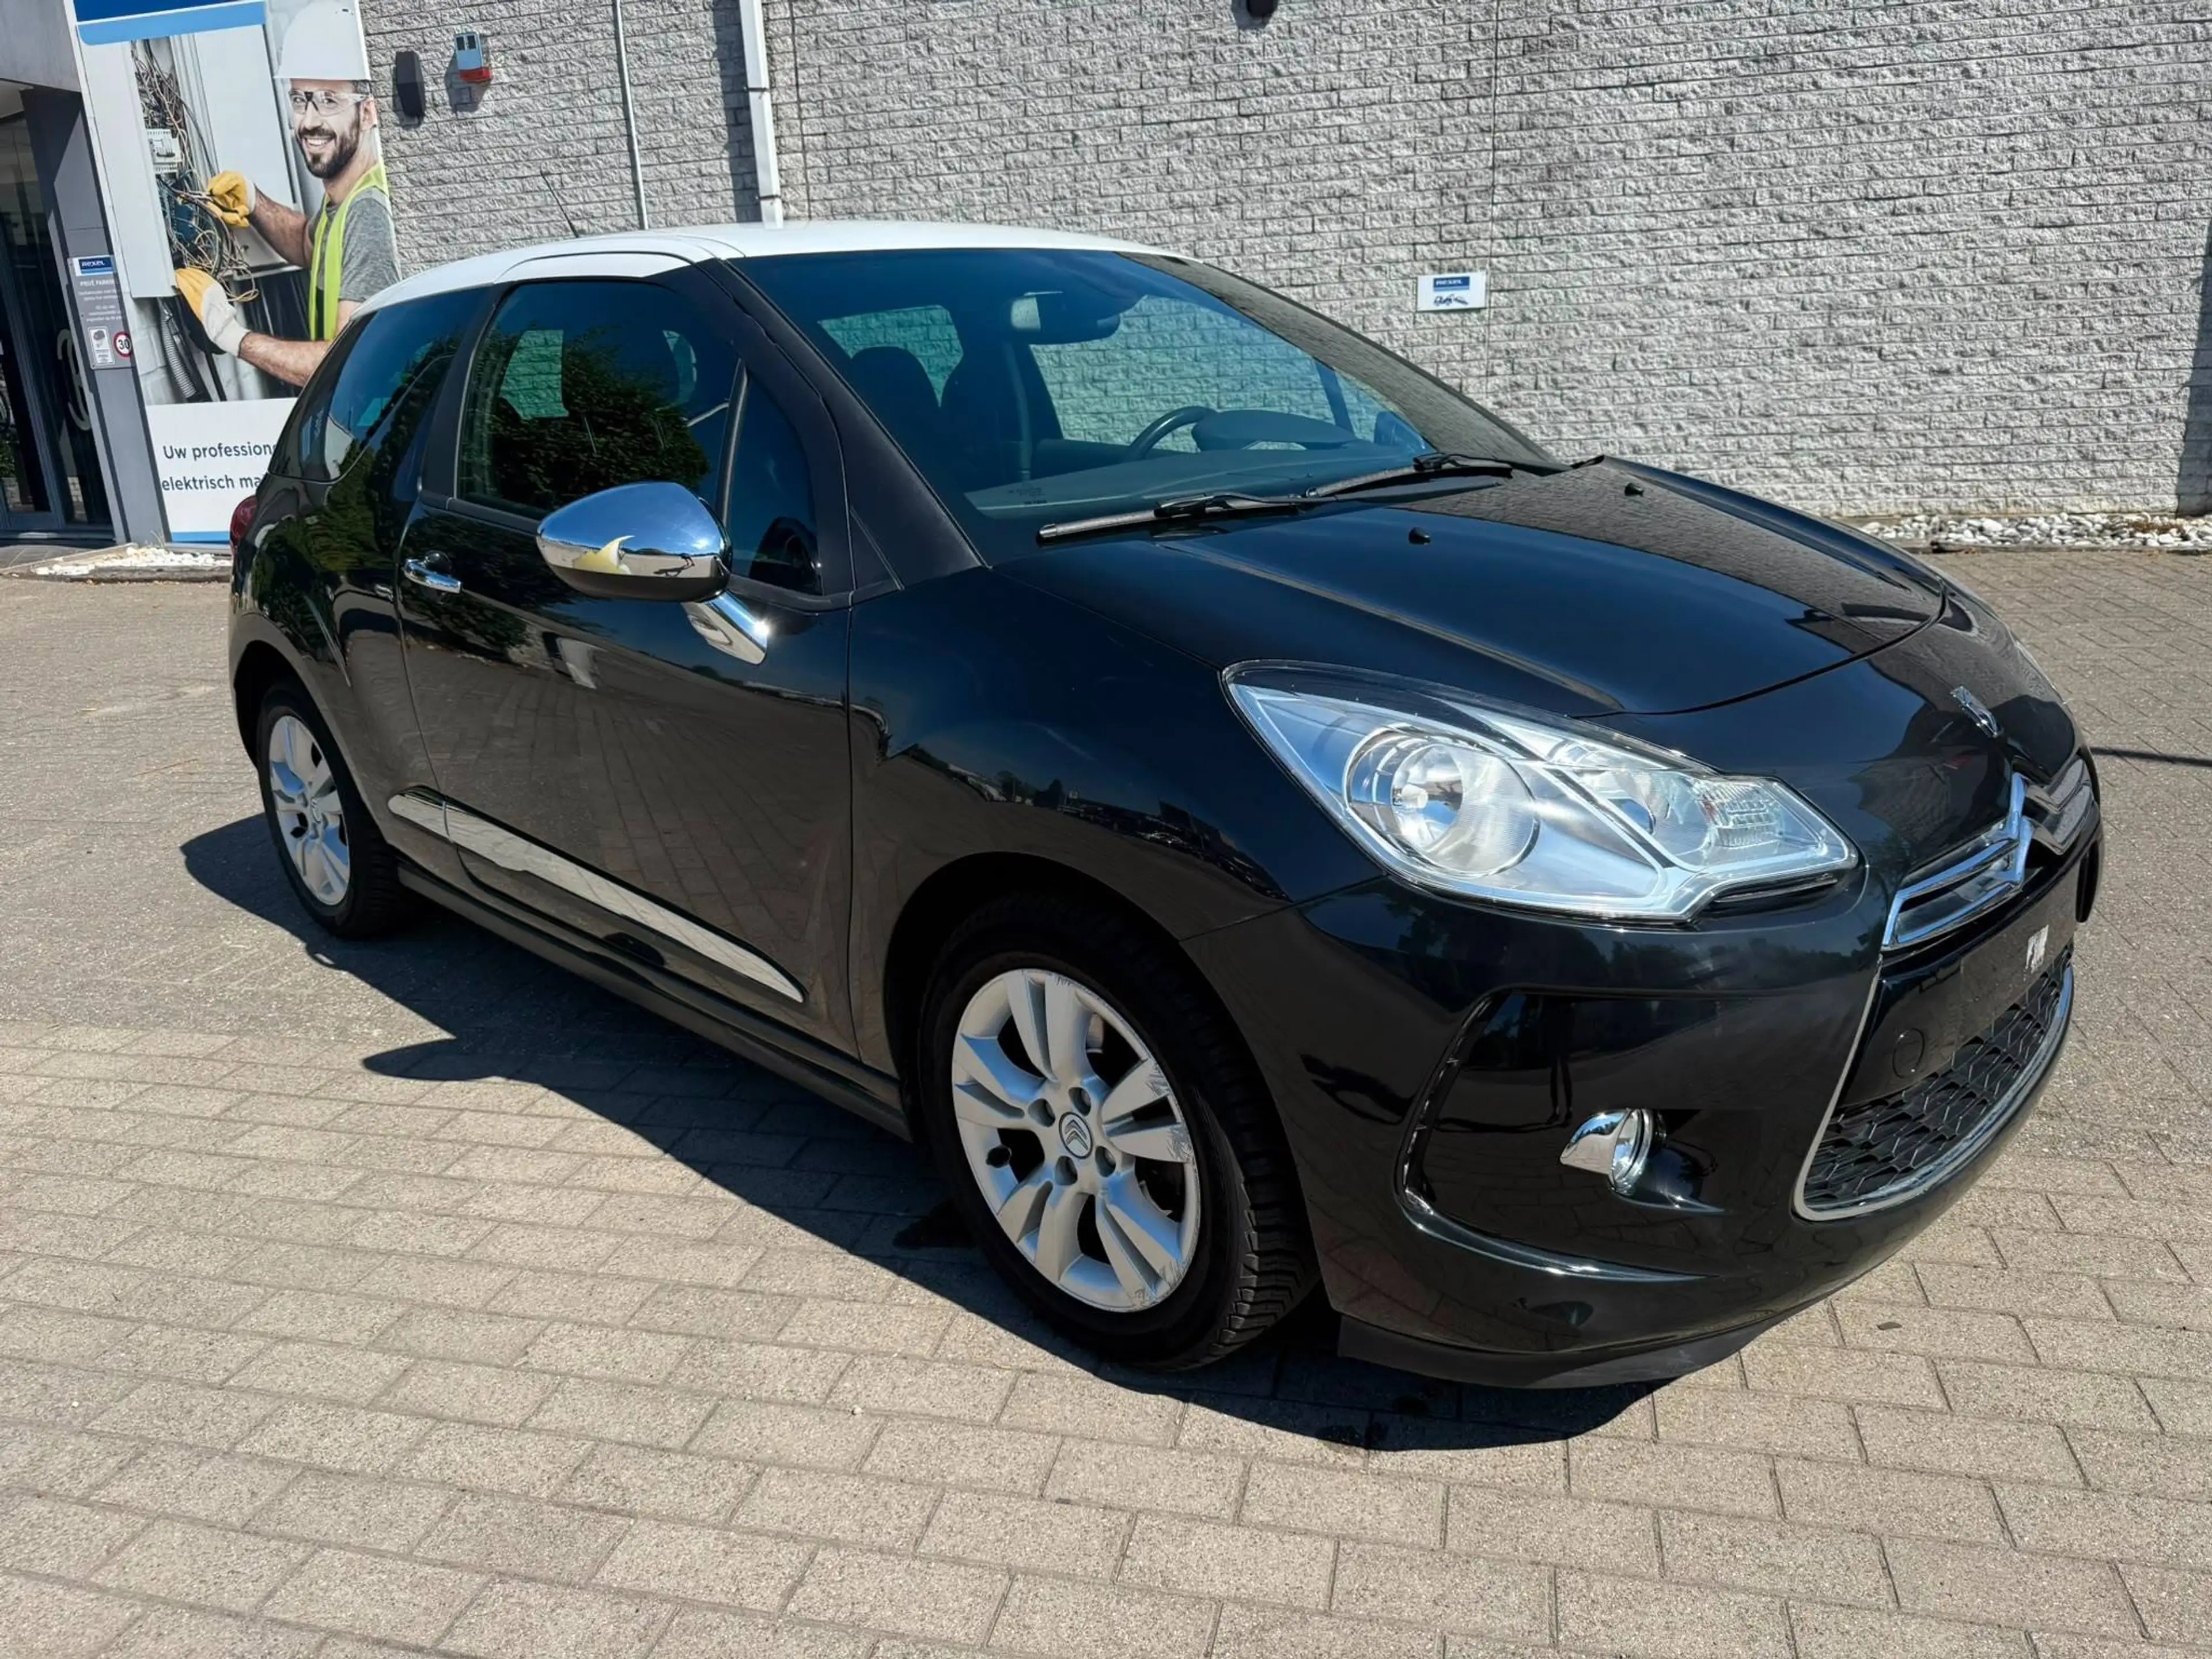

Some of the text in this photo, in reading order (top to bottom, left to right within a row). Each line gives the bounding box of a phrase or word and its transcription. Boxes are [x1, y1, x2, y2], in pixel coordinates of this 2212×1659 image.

[118, 339, 130, 350] 30
[163, 445, 187, 459] Uw
[162, 474, 234, 491] elektrisch
